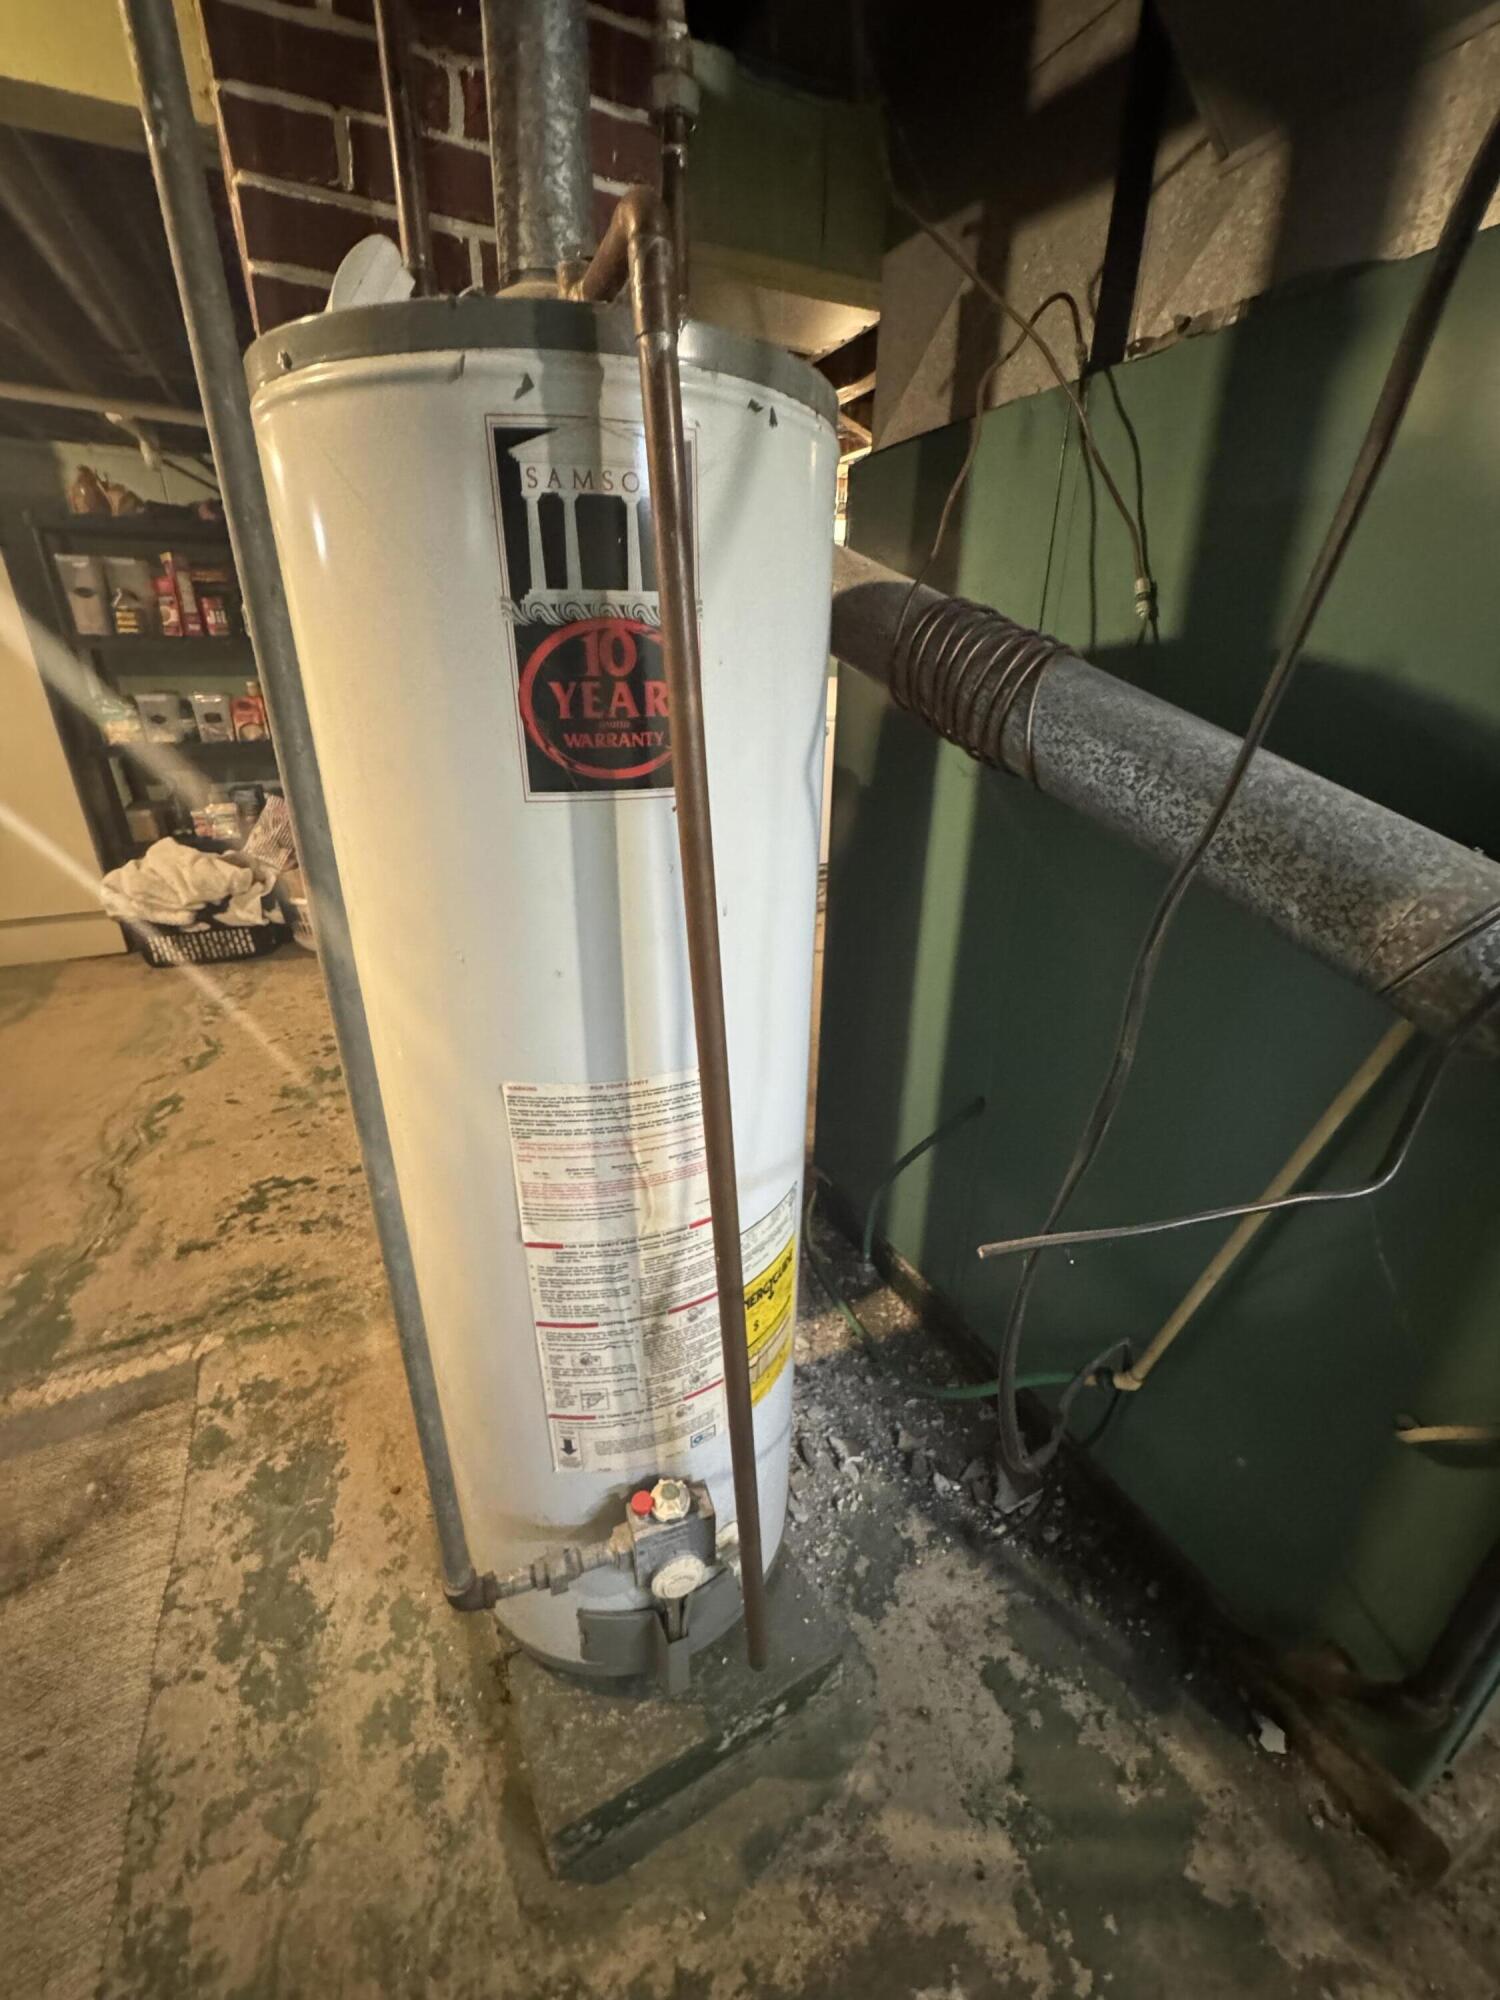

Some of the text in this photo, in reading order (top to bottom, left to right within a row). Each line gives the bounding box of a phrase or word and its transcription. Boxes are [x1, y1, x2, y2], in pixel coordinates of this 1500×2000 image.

[526, 466, 640, 493] SAMSO
[585, 628, 637, 677] 10
[549, 681, 670, 718] YEAR
[563, 731, 664, 748] WARRANTY
